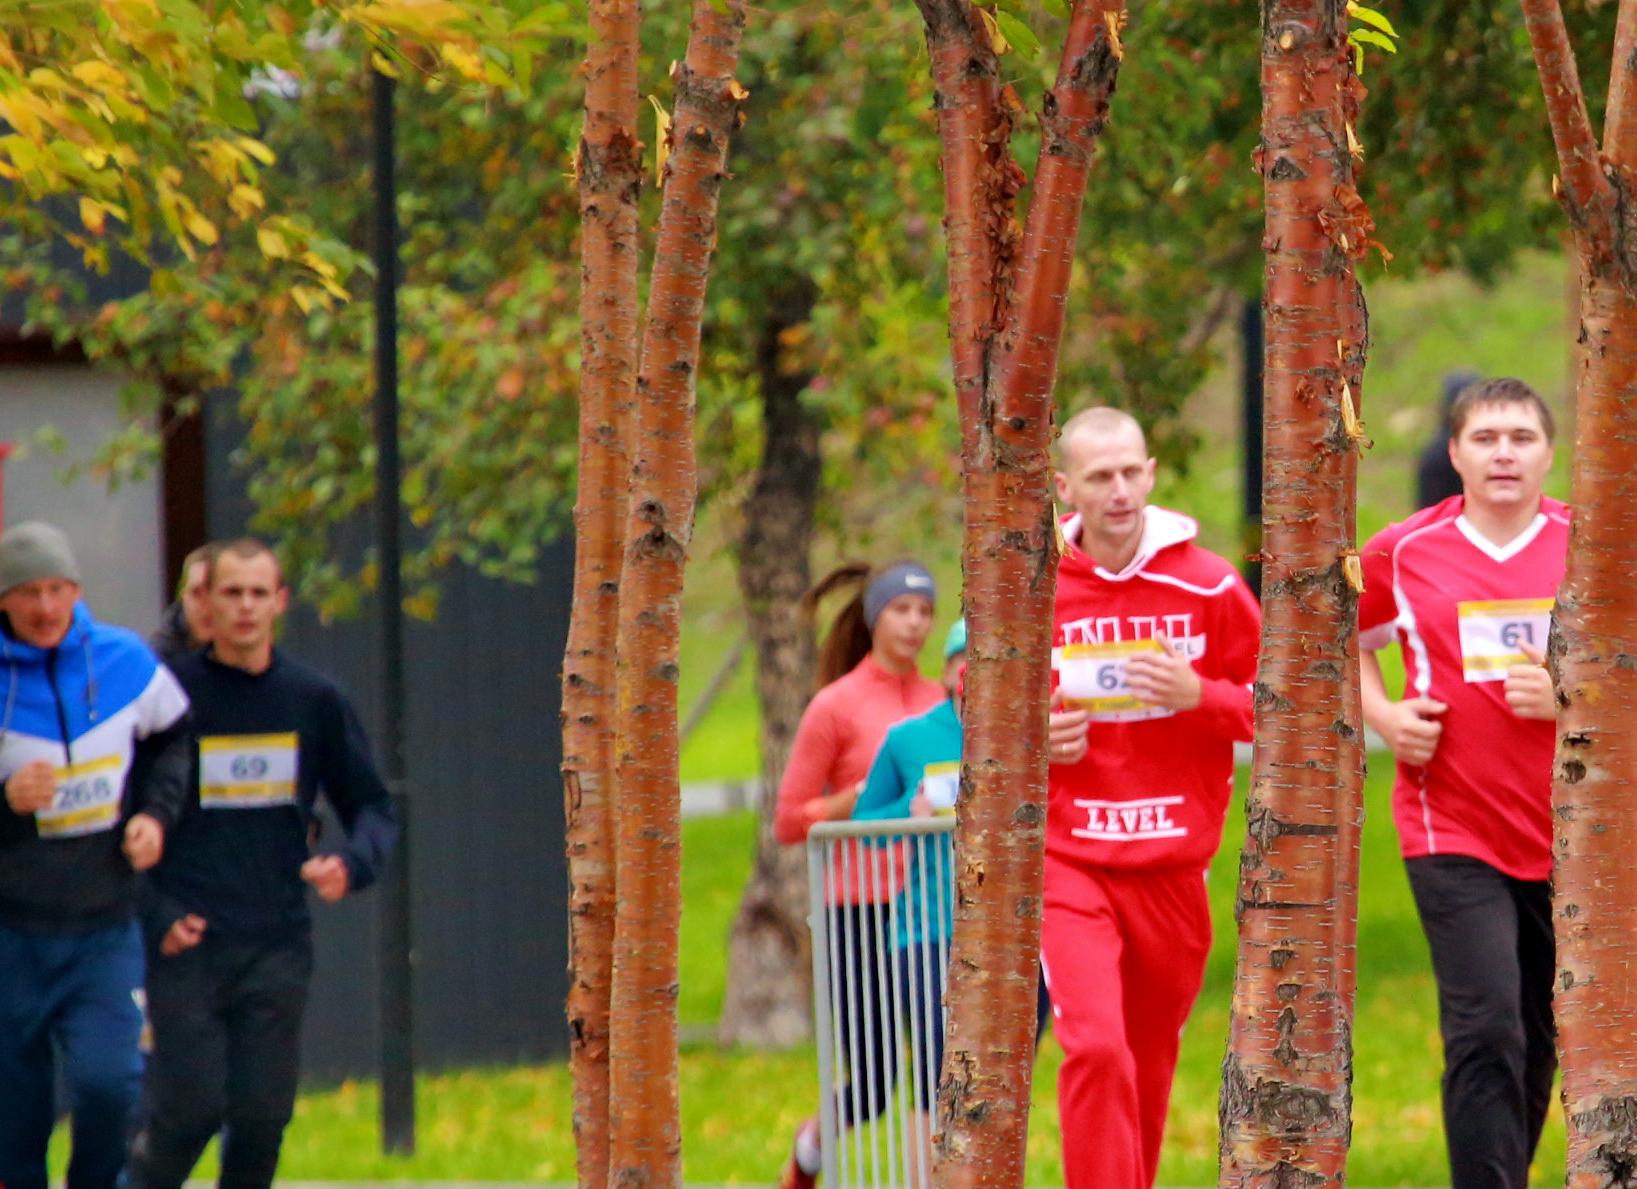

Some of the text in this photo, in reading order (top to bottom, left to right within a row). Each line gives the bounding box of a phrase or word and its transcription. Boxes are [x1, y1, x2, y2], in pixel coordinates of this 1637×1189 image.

[1501, 621, 1534, 649] 61
[230, 754, 268, 780] 69
[1086, 805, 1175, 833] LEVEL
